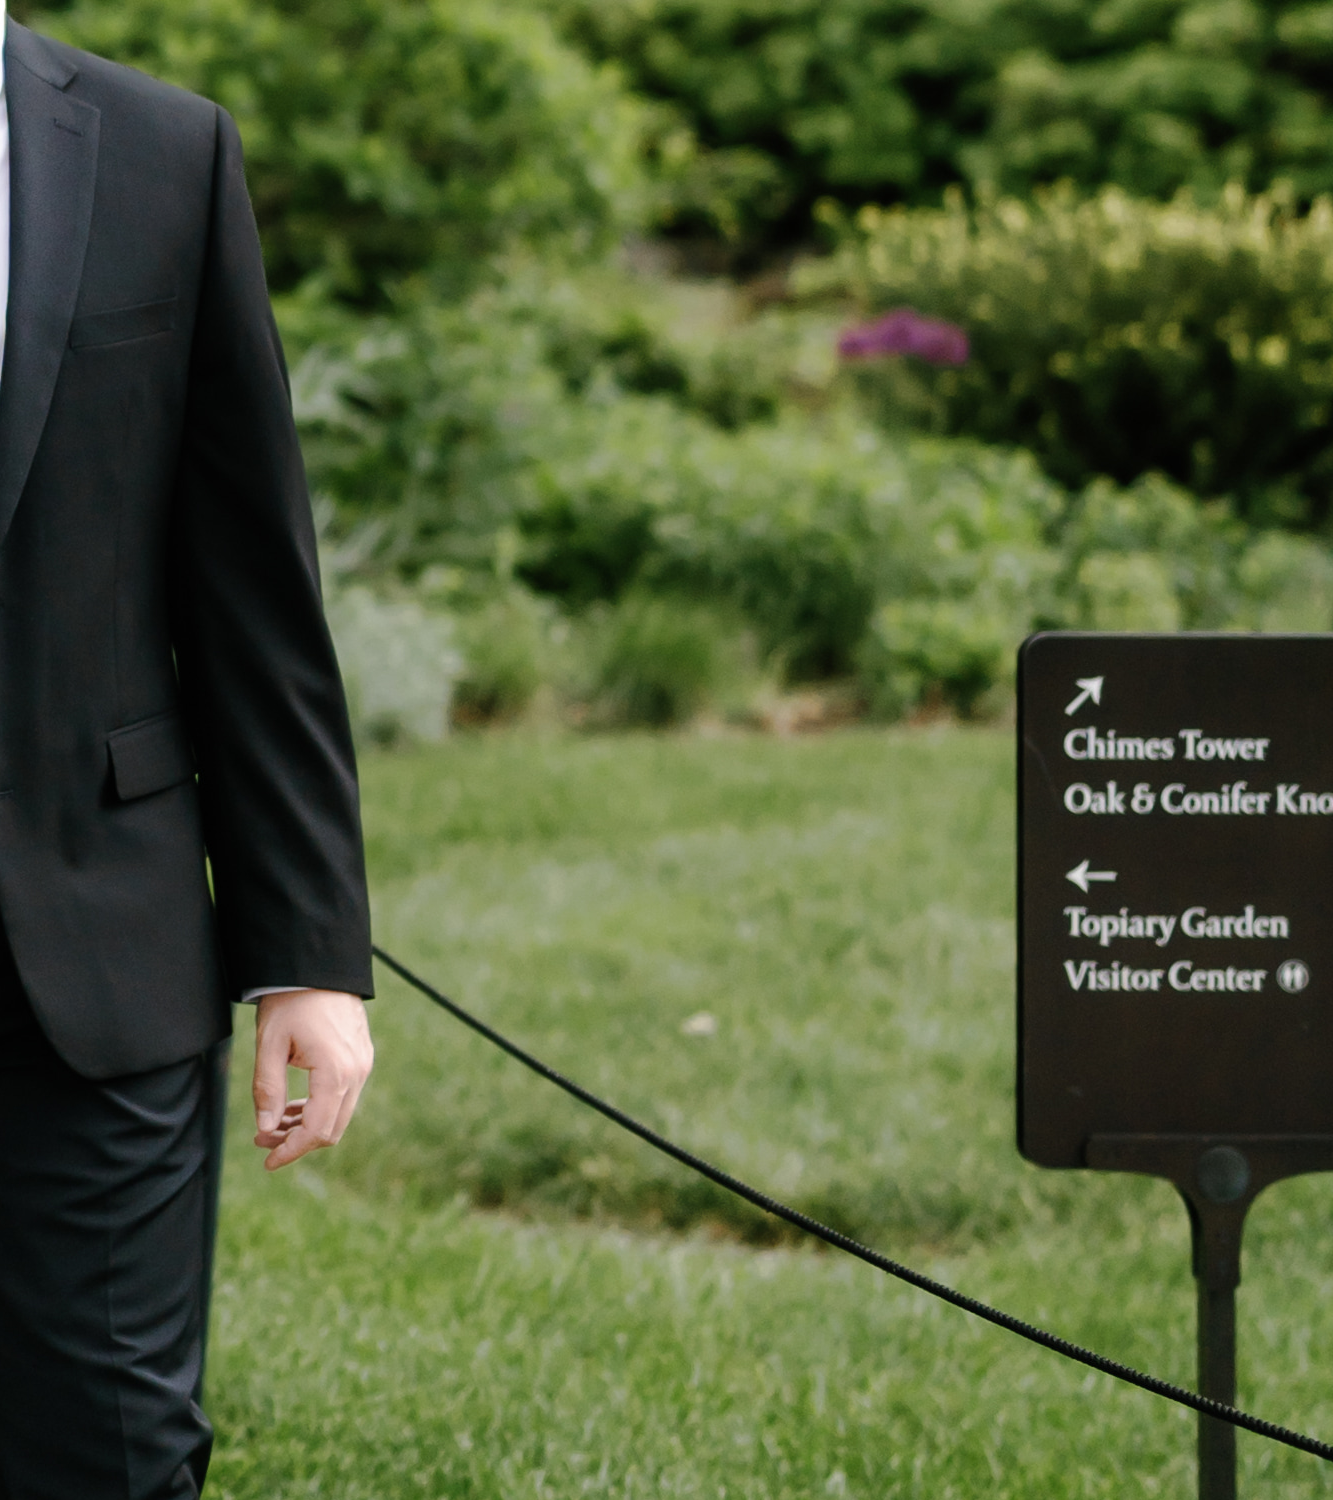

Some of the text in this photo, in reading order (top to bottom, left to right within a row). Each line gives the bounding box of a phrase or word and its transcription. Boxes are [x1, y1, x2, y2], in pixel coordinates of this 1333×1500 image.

[1063, 726, 1270, 761] Chimes Tower
[1063, 780, 1127, 815] Oak
[1131, 782, 1155, 815] &
[1161, 780, 1271, 815] Conifer
[1063, 904, 1289, 947] Topiary Garden
[1063, 959, 1267, 992] Visitor Center
